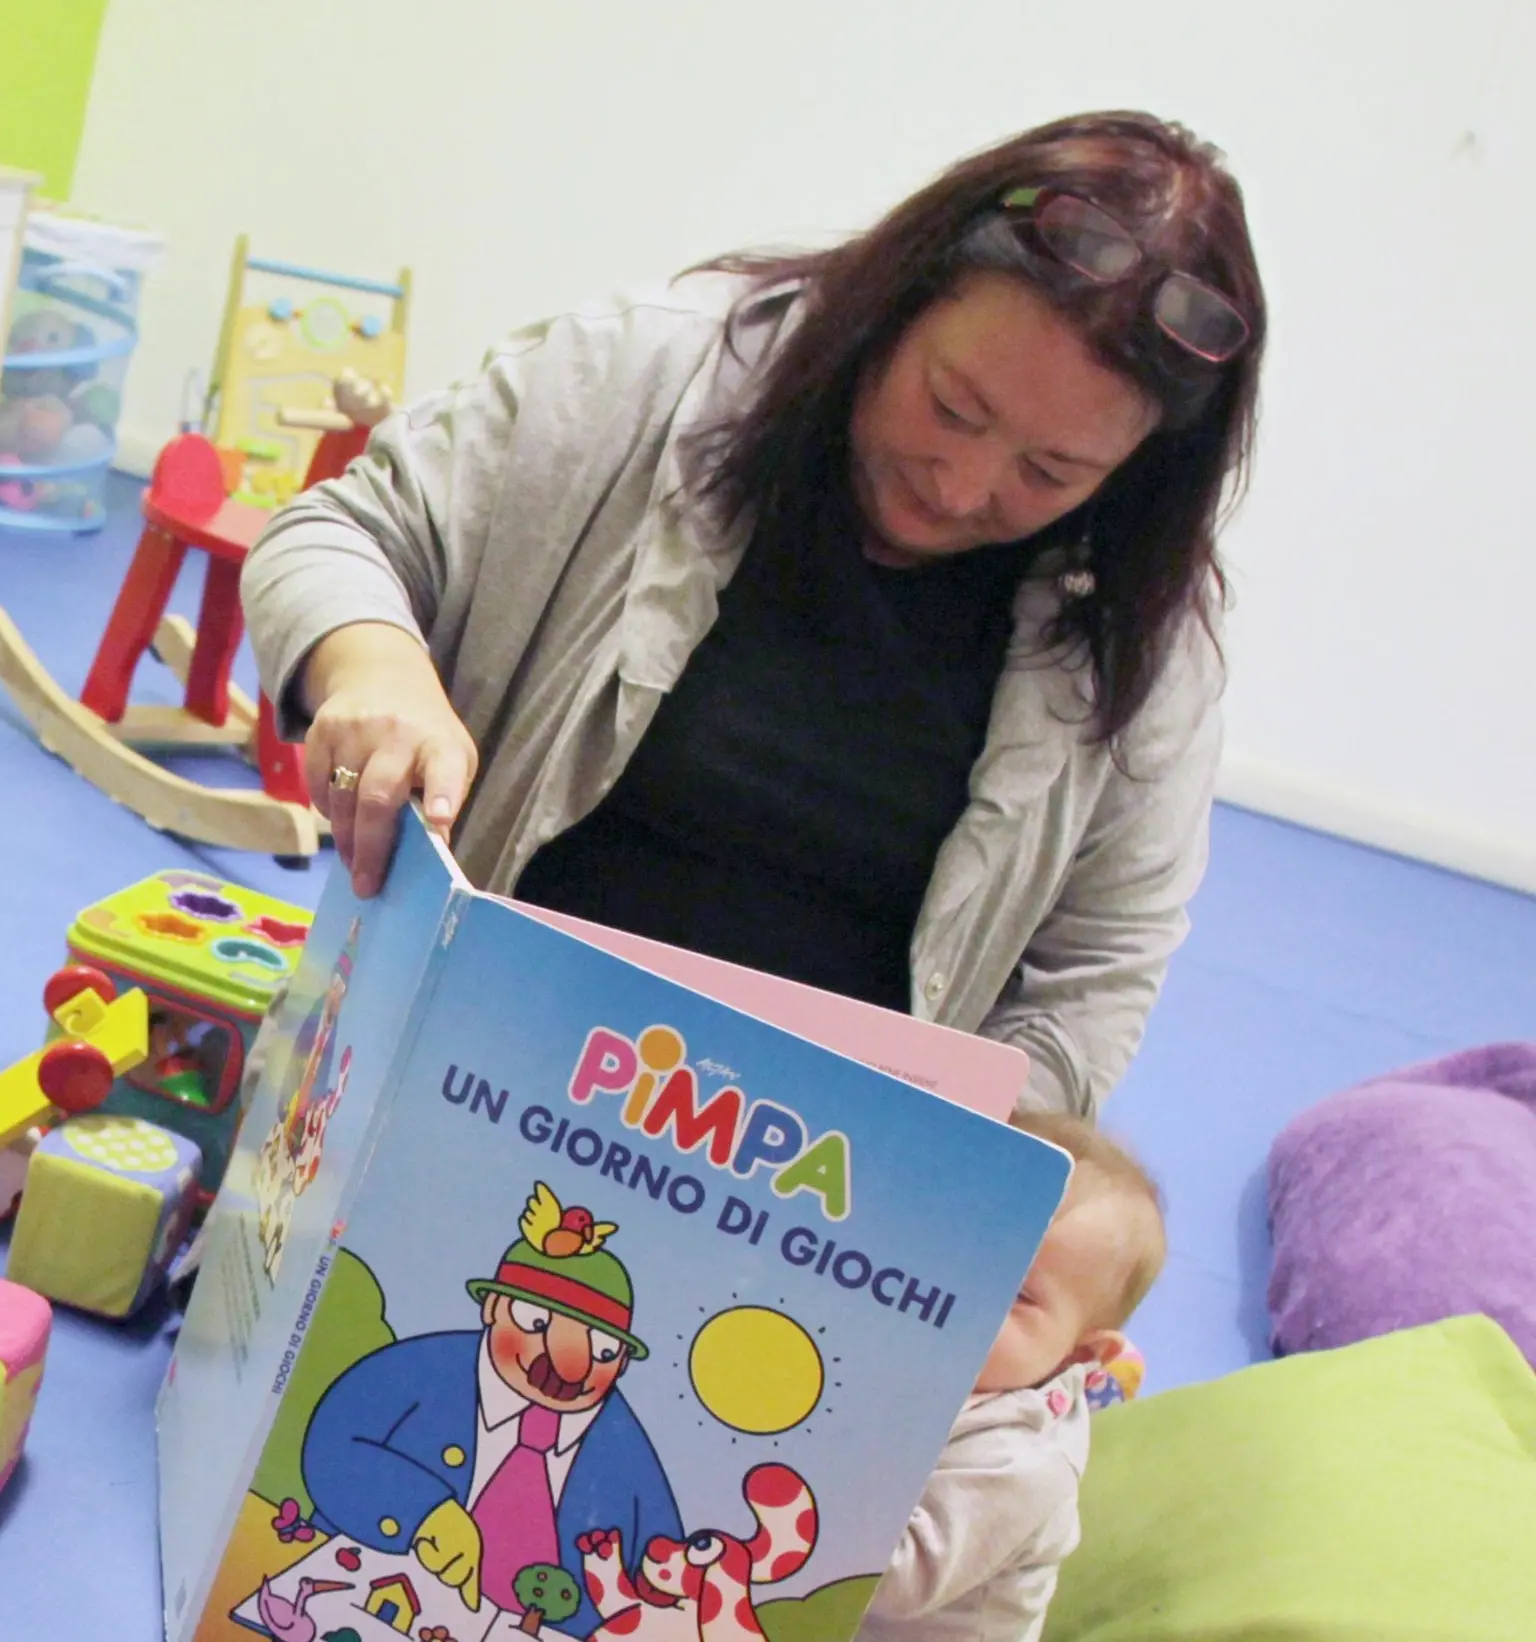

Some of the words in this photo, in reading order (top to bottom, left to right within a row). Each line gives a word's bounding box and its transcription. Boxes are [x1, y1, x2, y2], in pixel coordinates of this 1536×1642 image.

[442, 1064, 510, 1124] UN
[519, 1105, 706, 1214] GIORNO
[716, 1195, 770, 1246] DI
[780, 1226, 957, 1330] GIOCHI
[315, 1255, 331, 1277] UN
[295, 1278, 323, 1331] GIORNO
[288, 1333, 302, 1350] DI
[271, 1349, 296, 1395] GIOCHI
